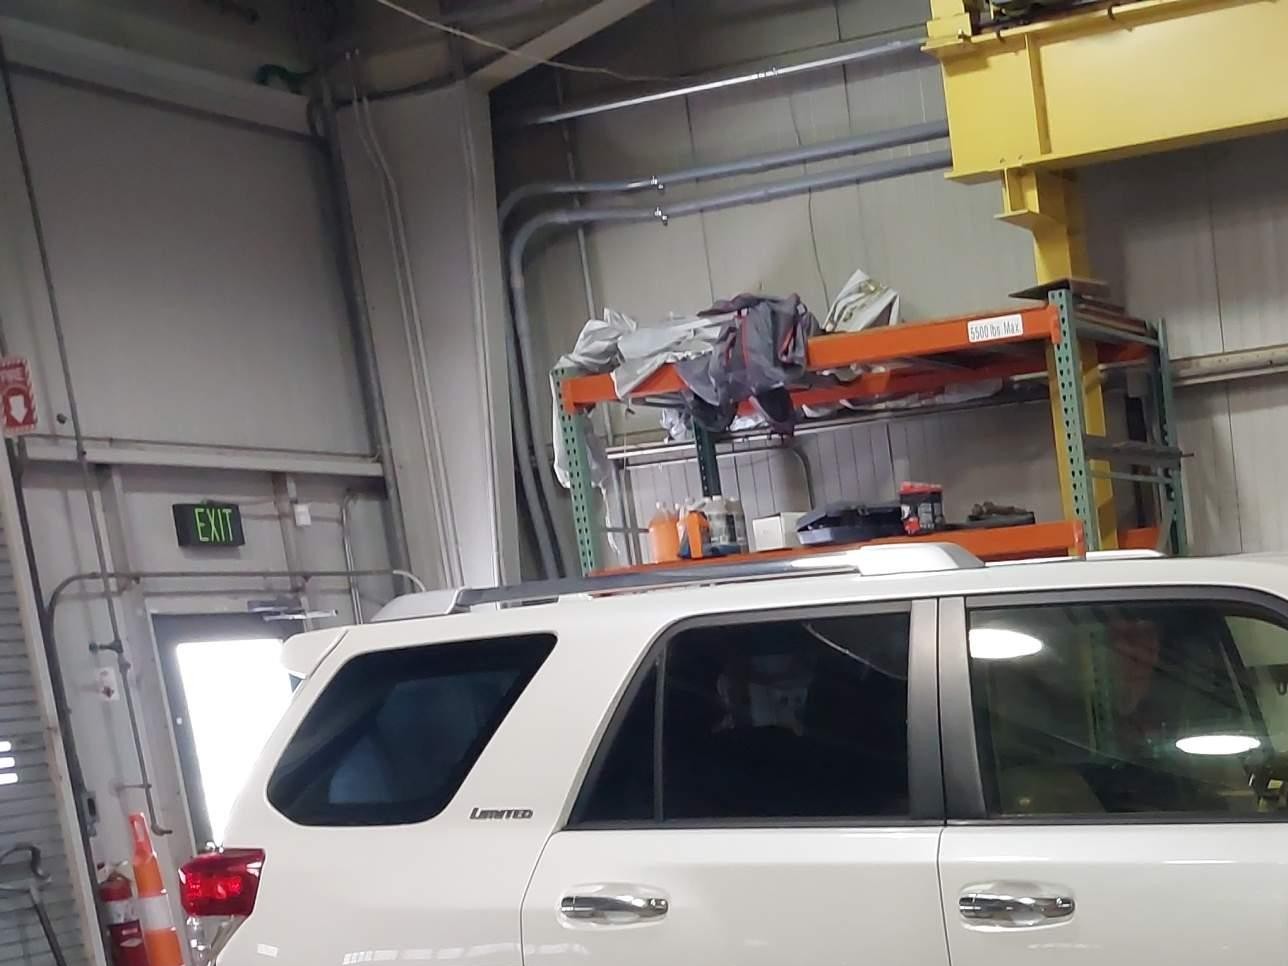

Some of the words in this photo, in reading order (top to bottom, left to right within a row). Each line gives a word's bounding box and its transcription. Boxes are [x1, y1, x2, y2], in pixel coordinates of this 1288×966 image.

[969, 323, 989, 340] 5500
[194, 507, 233, 542] EXIT
[470, 807, 533, 819] LIMITED
